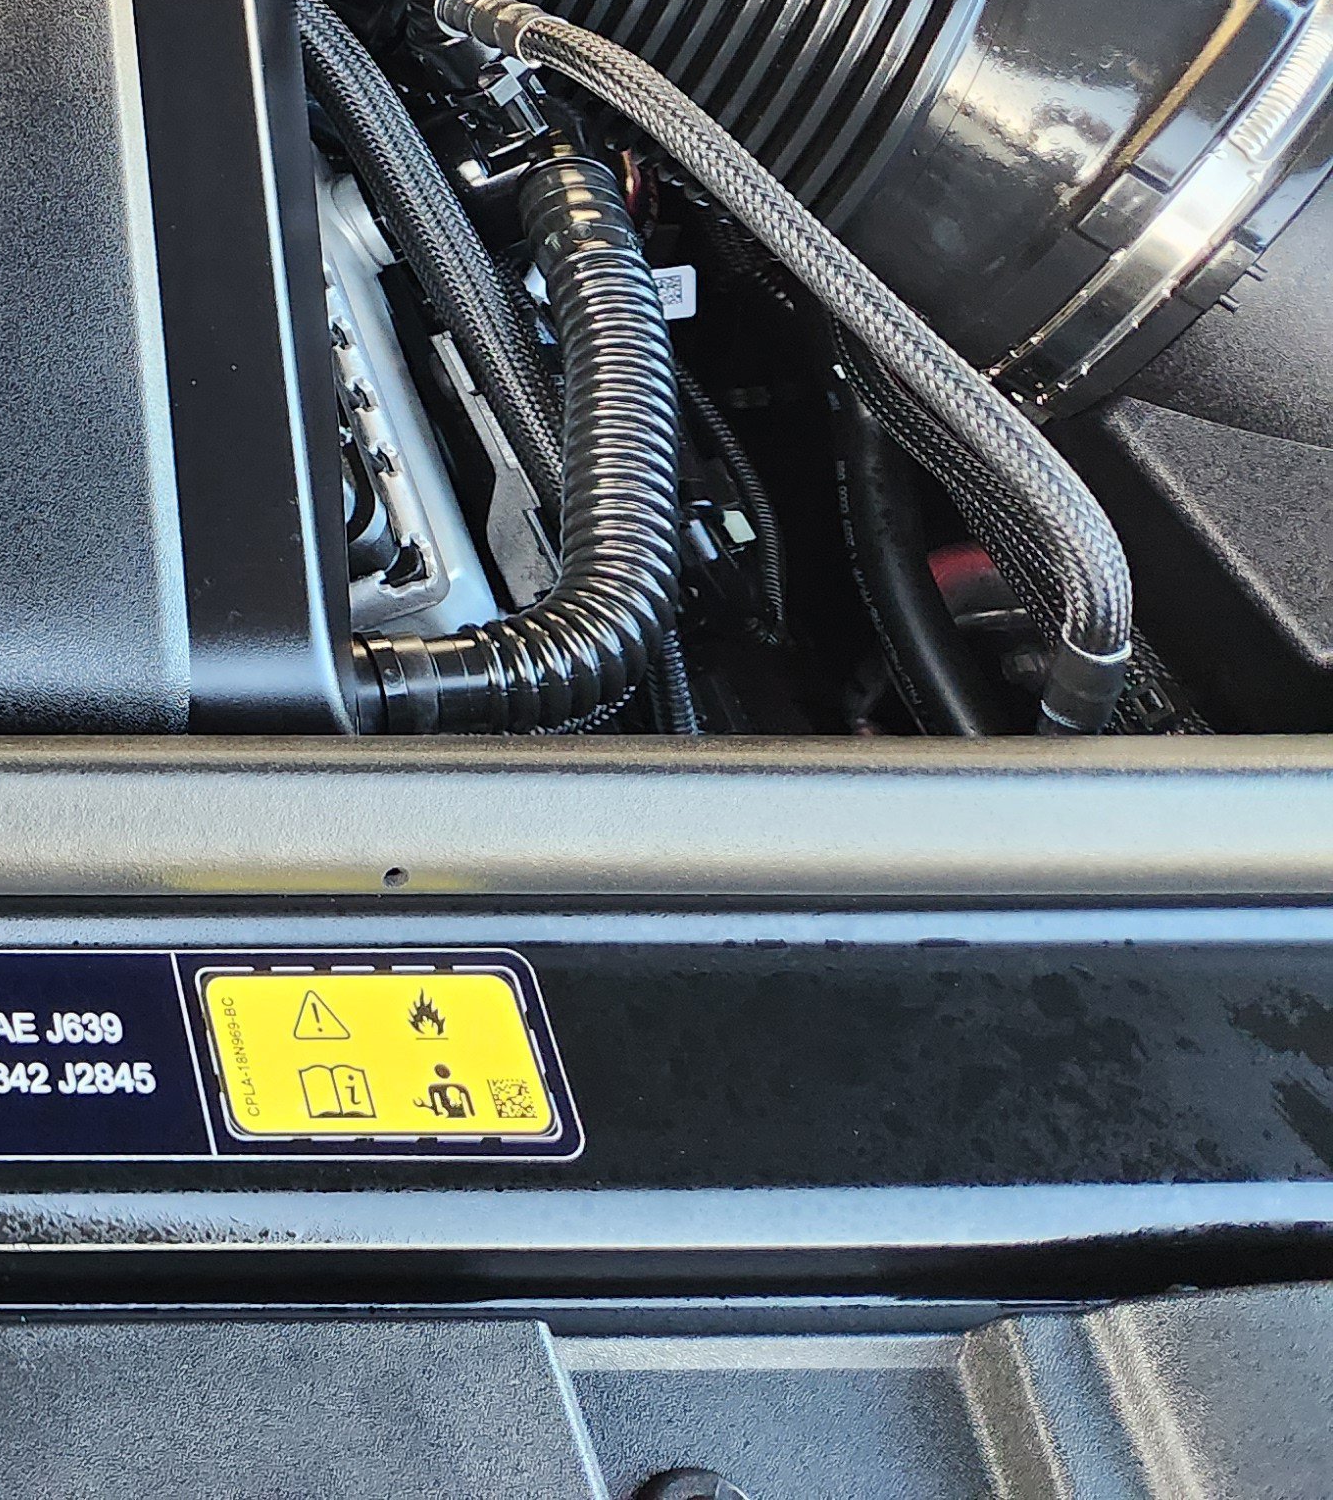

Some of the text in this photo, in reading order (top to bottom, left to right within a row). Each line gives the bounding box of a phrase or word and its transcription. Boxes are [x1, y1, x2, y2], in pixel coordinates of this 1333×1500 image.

[45, 1011, 124, 1044] J639
[220, 996, 261, 1118] CPLA-18N969-BC
[58, 1063, 157, 1095] J2845
